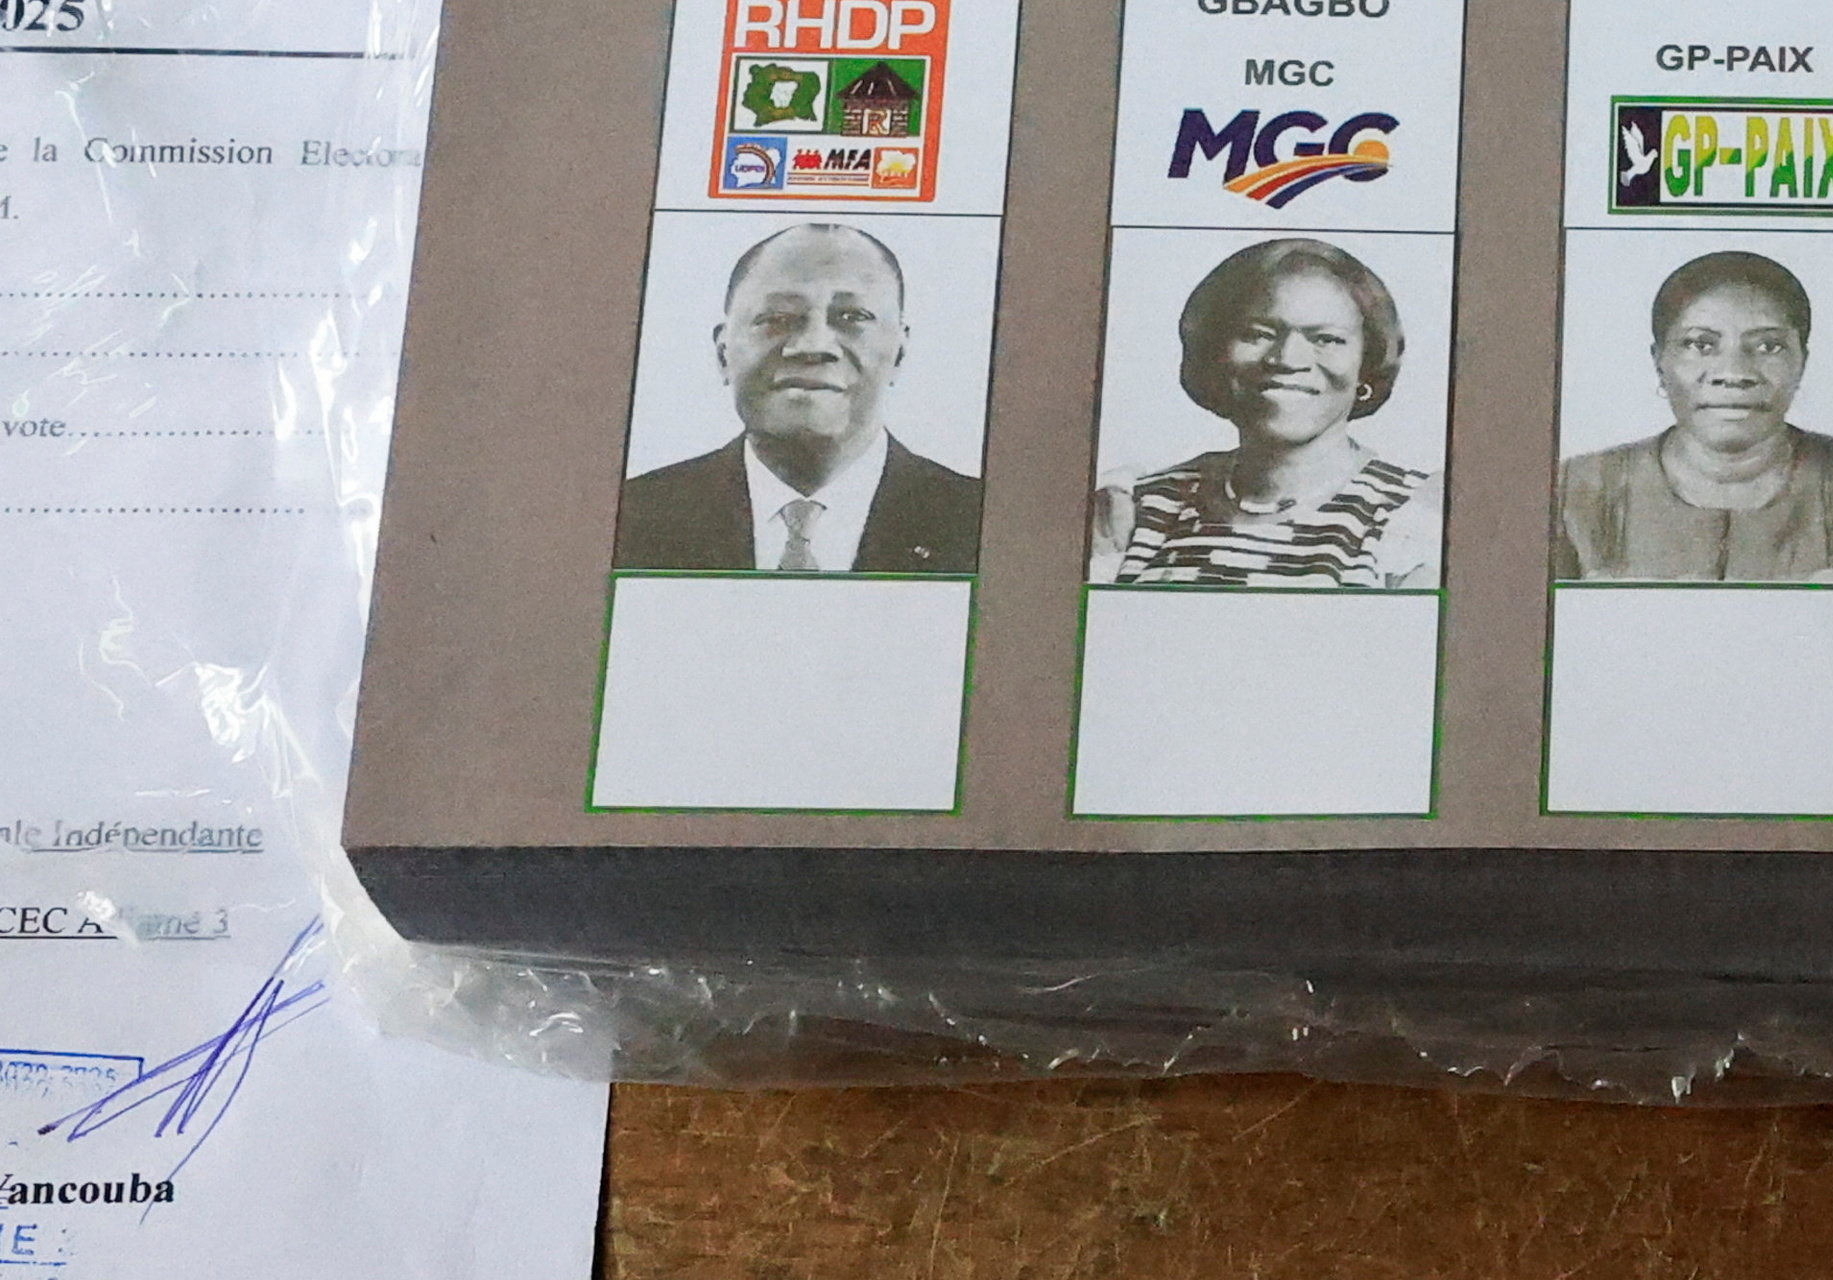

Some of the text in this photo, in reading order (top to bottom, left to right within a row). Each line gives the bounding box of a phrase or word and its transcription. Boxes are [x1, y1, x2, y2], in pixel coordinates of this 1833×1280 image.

[1244, 58, 1335, 88] MGC
[1655, 43, 1815, 73] GP-PAIX
[33, 136, 57, 163] la
[85, 137, 274, 167] Commission
[823, 148, 872, 171] MFA
[1167, 107, 1400, 189] MGC
